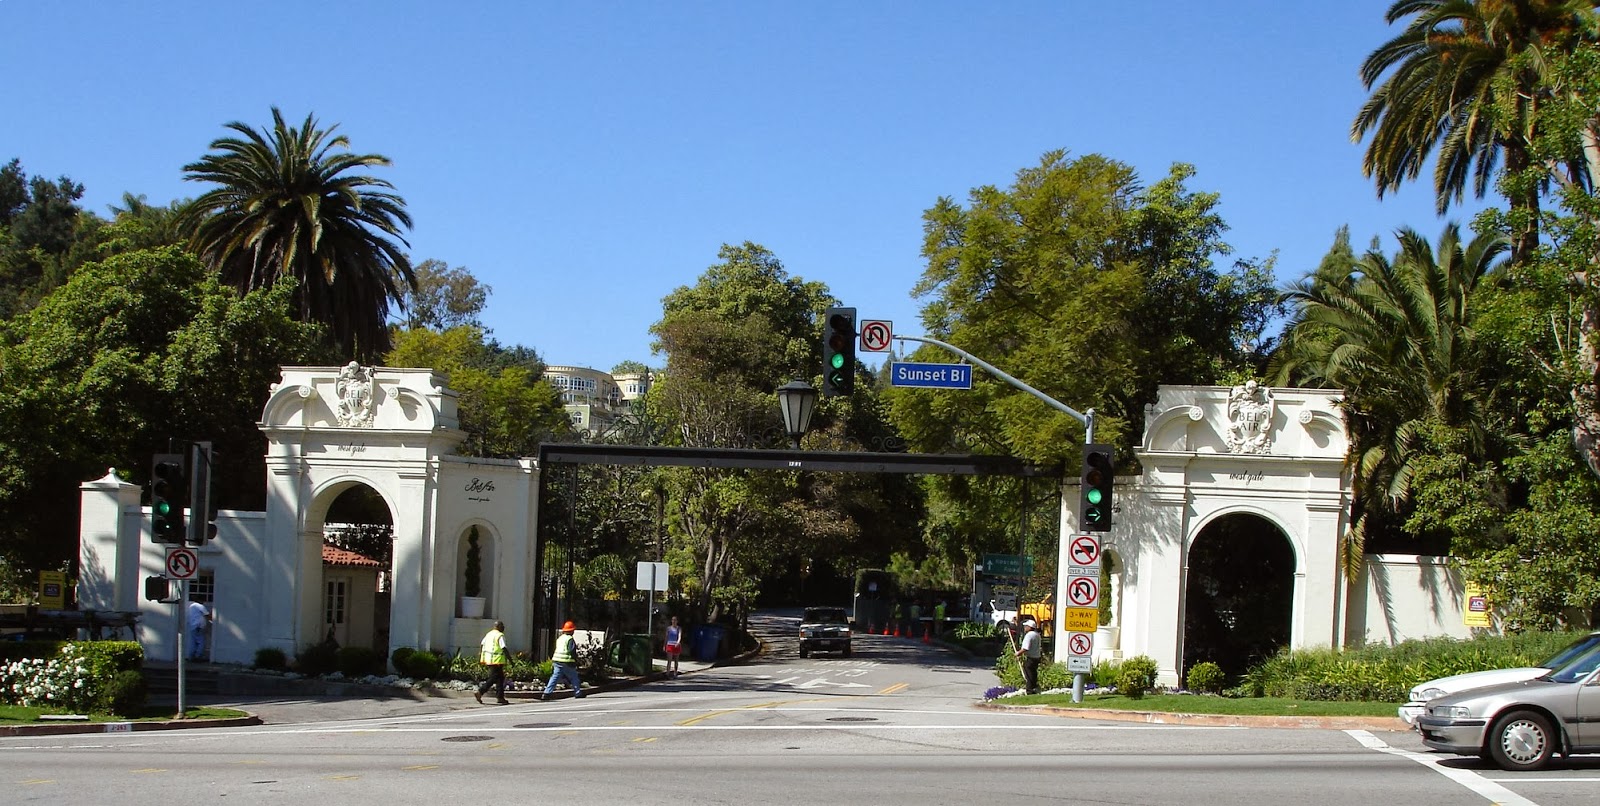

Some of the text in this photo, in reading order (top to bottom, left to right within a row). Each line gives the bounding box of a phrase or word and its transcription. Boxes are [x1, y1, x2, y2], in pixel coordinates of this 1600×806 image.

[898, 367, 965, 382] Sunset Bl
[345, 389, 363, 399] BEL
[1239, 411, 1260, 422] BEL
[1241, 422, 1259, 432] AIR
[1229, 470, 1264, 486] west gate
